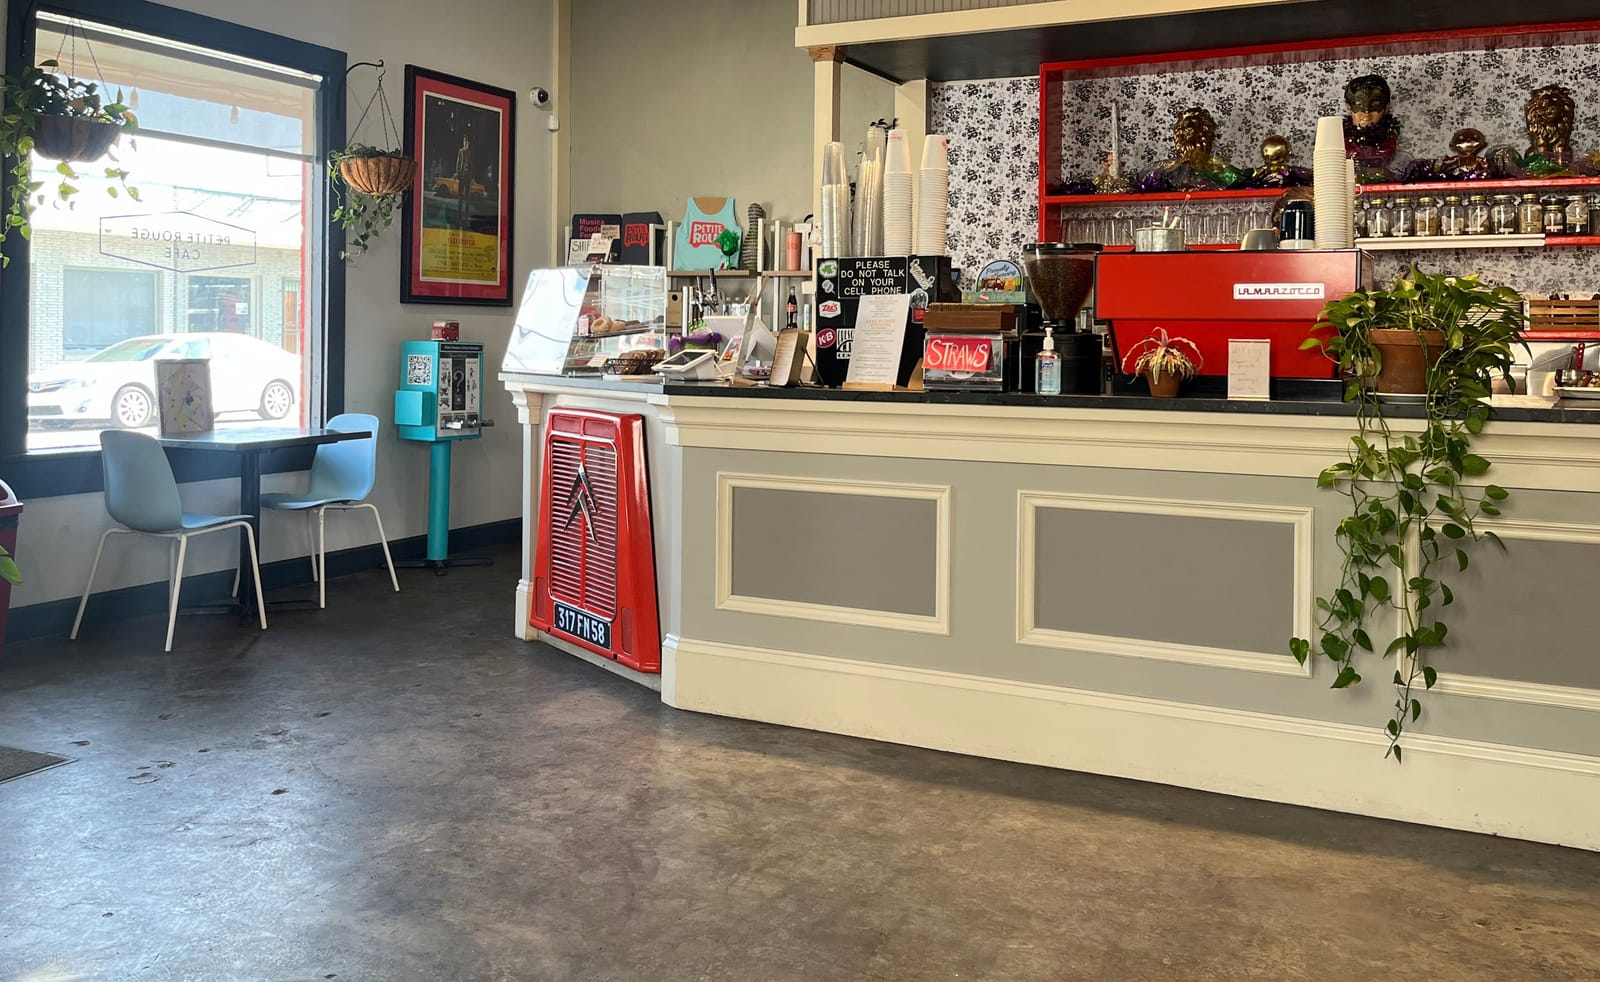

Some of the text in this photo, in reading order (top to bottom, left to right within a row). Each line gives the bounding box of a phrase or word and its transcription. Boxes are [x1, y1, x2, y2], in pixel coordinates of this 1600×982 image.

[694, 224, 722, 234] PETITE
[855, 260, 890, 270] PLEASE
[840, 269, 905, 279] DO NOT TALK
[852, 278, 894, 287] ON YOUR
[844, 286, 902, 296] CELL PHONE
[927, 339, 988, 369] STRAWS
[558, 607, 605, 644] 317 FN 58
